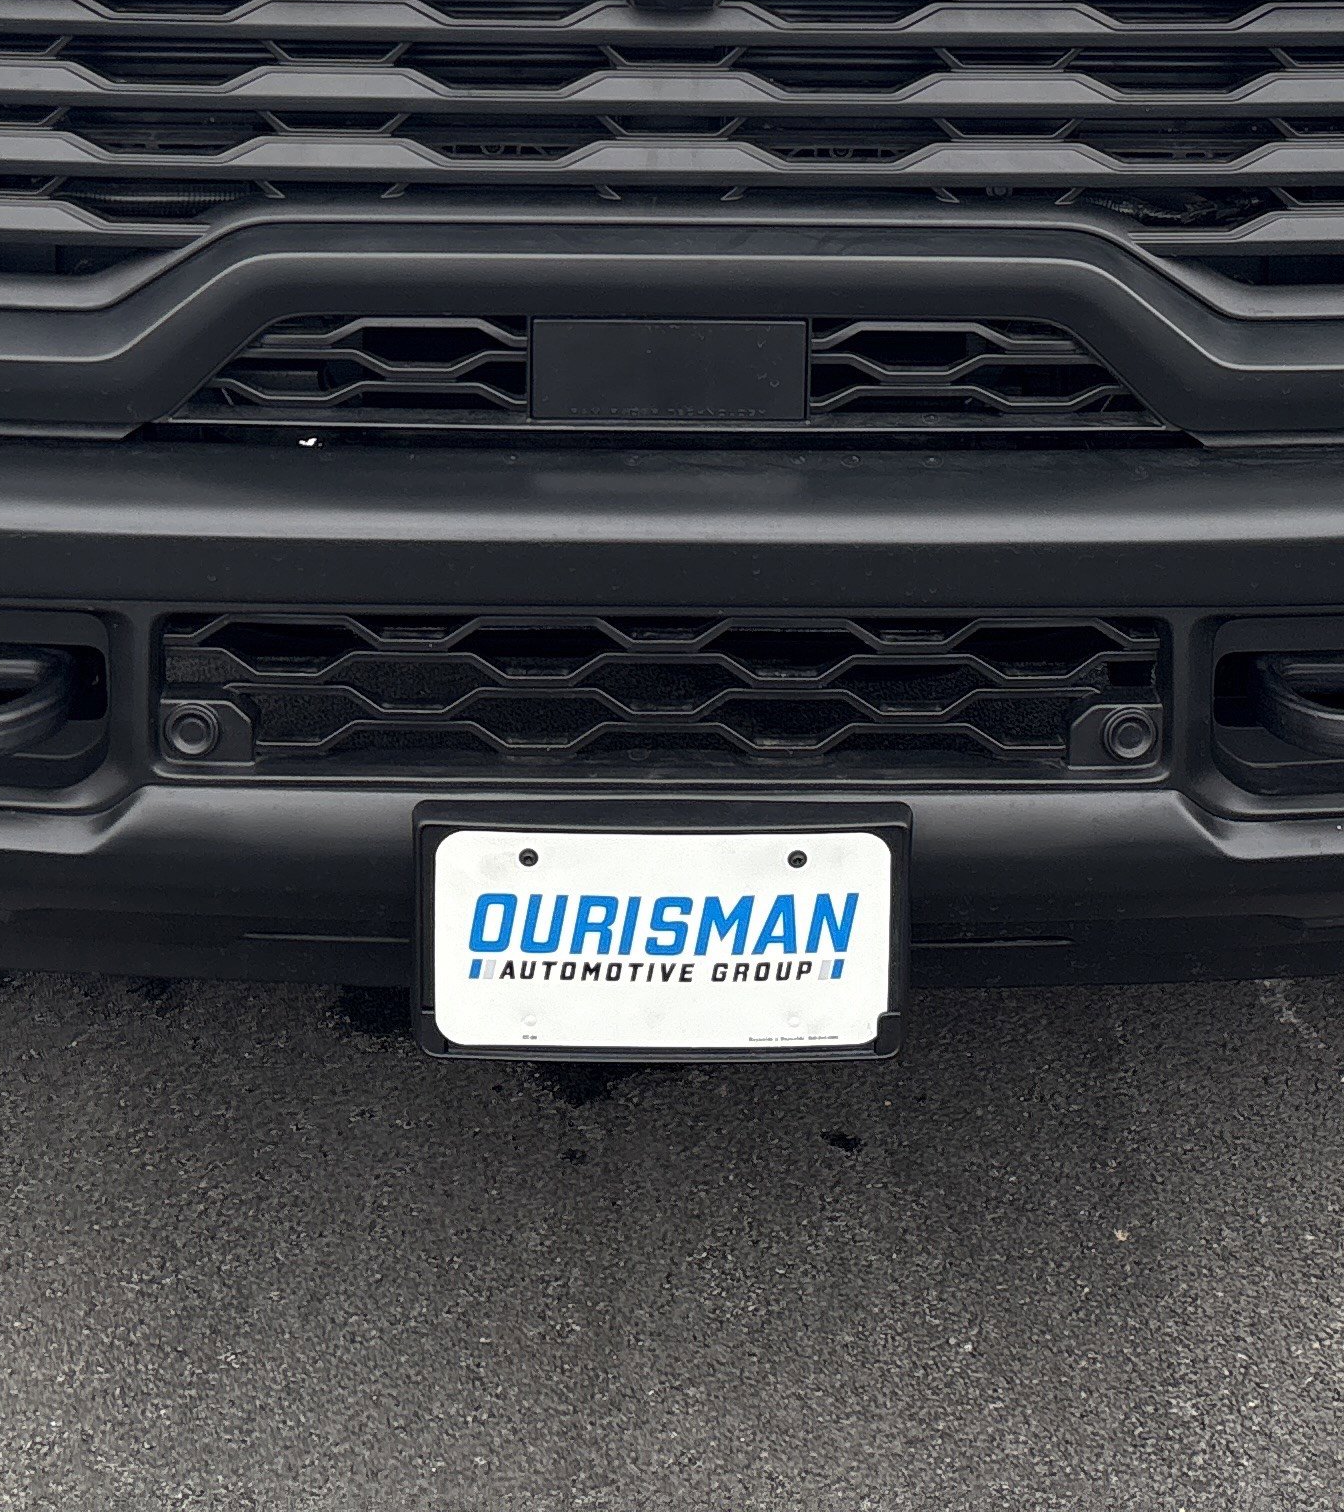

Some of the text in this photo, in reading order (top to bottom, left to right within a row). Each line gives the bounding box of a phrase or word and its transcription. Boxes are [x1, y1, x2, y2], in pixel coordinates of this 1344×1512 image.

[468, 892, 860, 956] OURISMAN
[499, 958, 813, 983] AUTOMOTIVE GROUP
